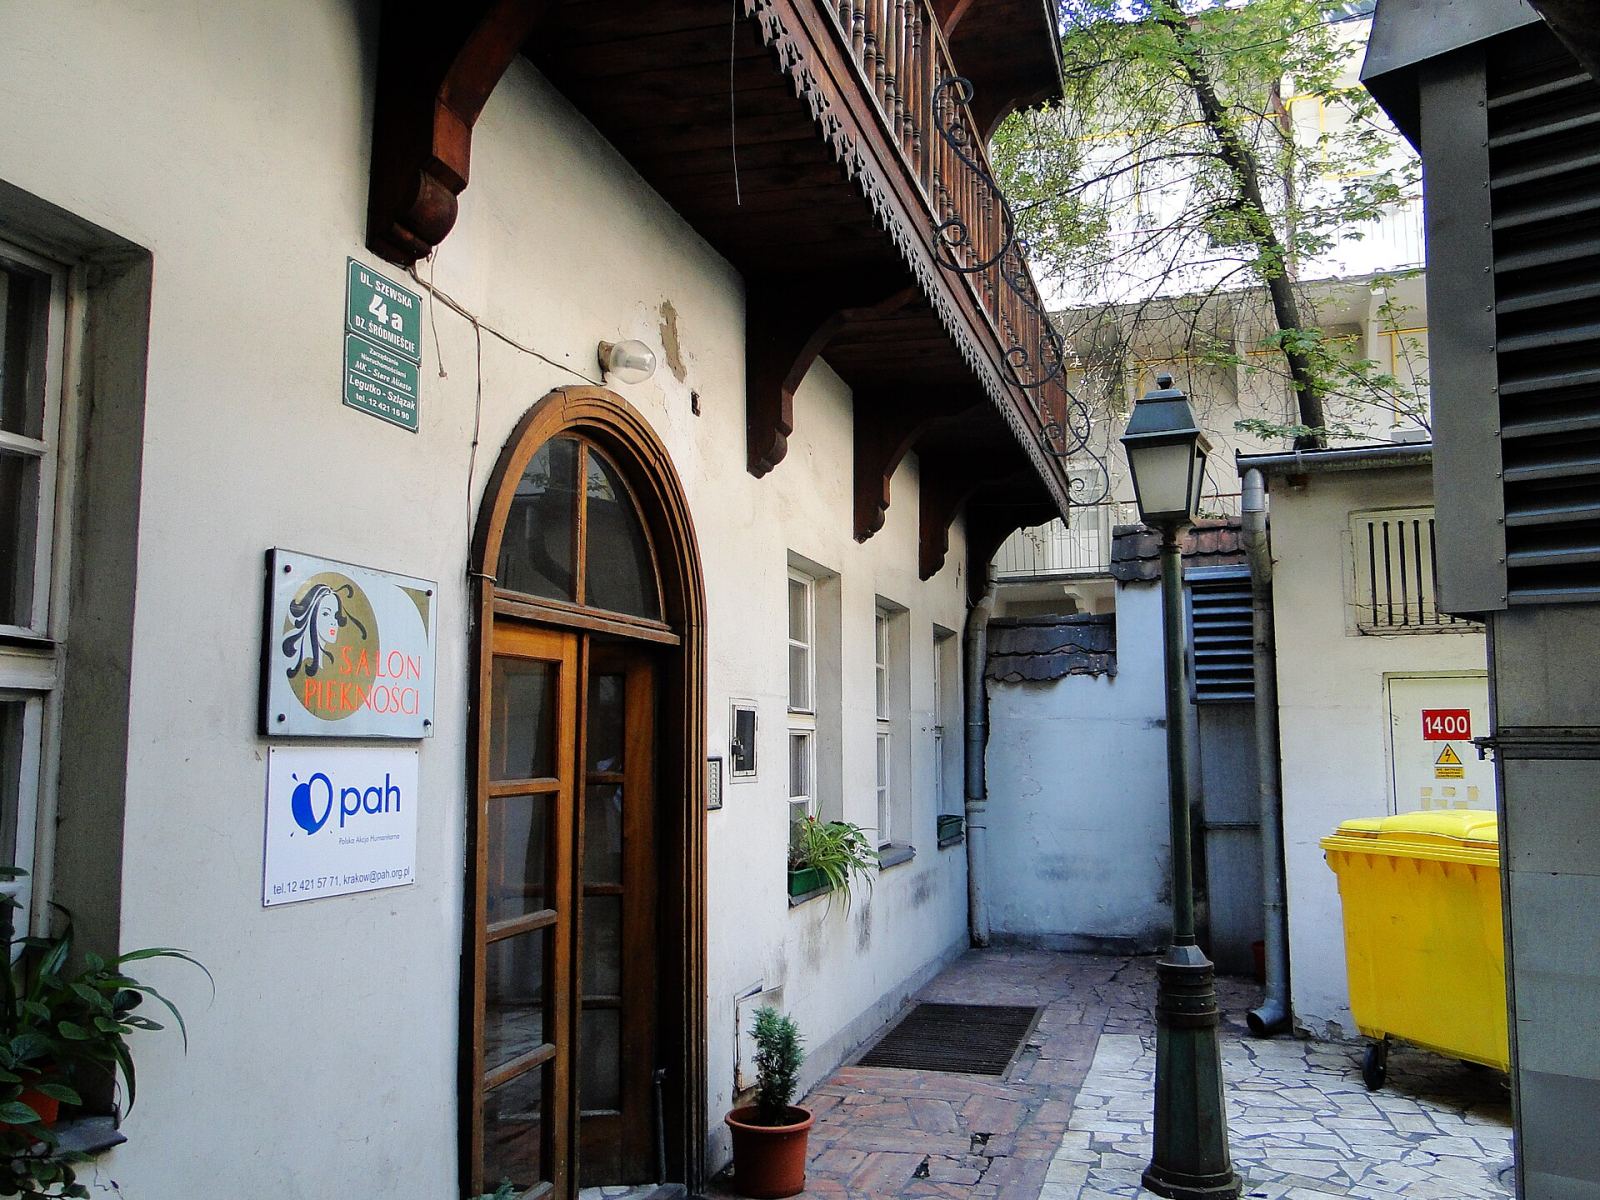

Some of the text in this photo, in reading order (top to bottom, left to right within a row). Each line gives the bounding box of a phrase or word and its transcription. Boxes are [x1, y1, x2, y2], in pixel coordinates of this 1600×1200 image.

[360, 271, 413, 309] UL. SZEWSKA
[355, 315, 415, 353] DZ. ŚRÓDMIEŚCIE
[349, 374, 381, 396] Legutko
[373, 368, 390, 382] Stare
[391, 376, 412, 391] Miasto
[368, 398, 377, 408] 12
[378, 402, 390, 412] 421
[339, 645, 421, 681] SALON
[304, 676, 419, 715] PIĘKNOŚCI
[1425, 716, 1468, 734] 1400
[340, 773, 401, 828] pah
[339, 837, 355, 845] Polska
[356, 835, 369, 844] Akcja
[299, 879, 314, 891] 421
[317, 877, 327, 889] 57
[343, 866, 410, 885] krakow@pah.org.pl
